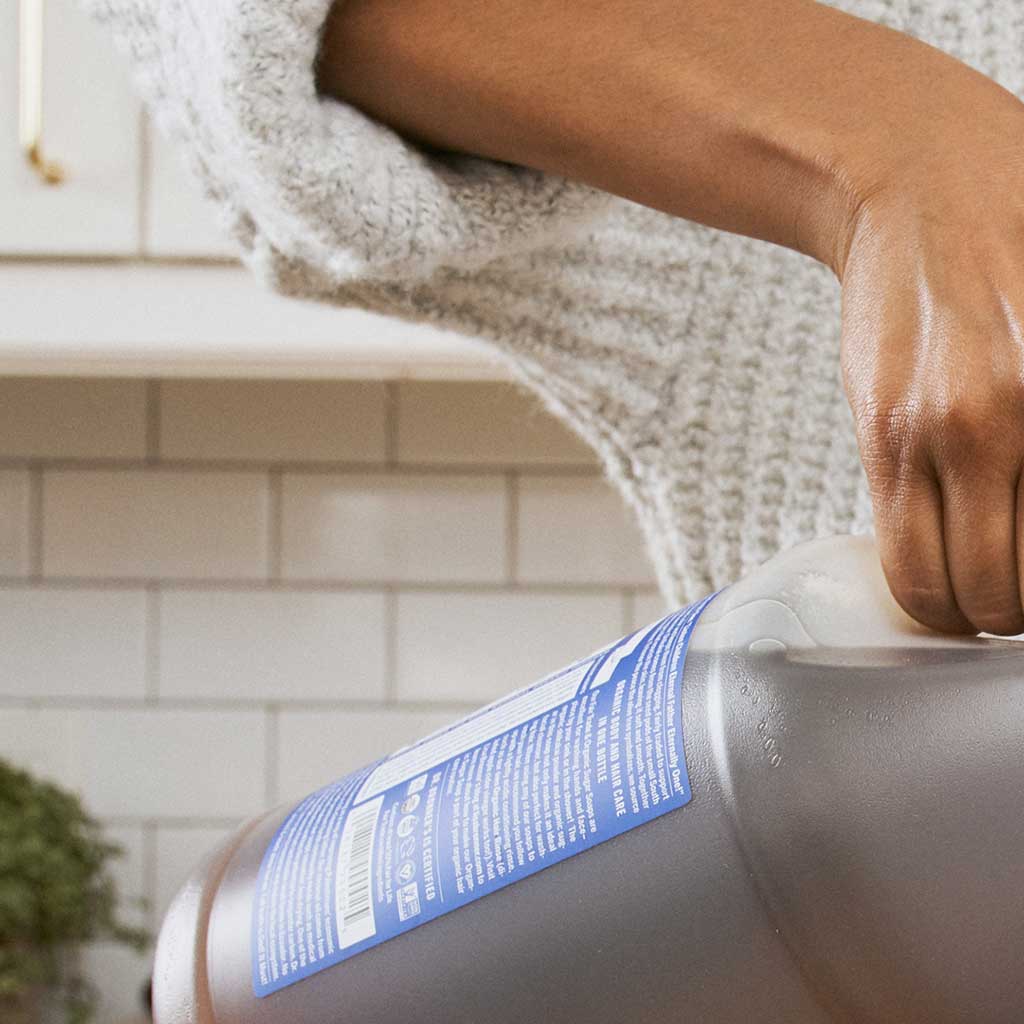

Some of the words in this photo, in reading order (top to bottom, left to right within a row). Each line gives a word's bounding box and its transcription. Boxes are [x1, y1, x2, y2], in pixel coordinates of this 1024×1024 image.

[608, 742, 621, 761] AND
[665, 727, 681, 768] Eternally
[594, 748, 608, 783] BOTTLE
[609, 763, 622, 788] HAIR
[638, 774, 649, 809] Together
[649, 780, 659, 804] South
[658, 768, 669, 800] support
[575, 798, 583, 813] and
[583, 792, 595, 818] Soaps
[613, 791, 625, 816] CARE
[568, 825, 576, 842] The
[420, 847, 436, 900] CERTIFIED
